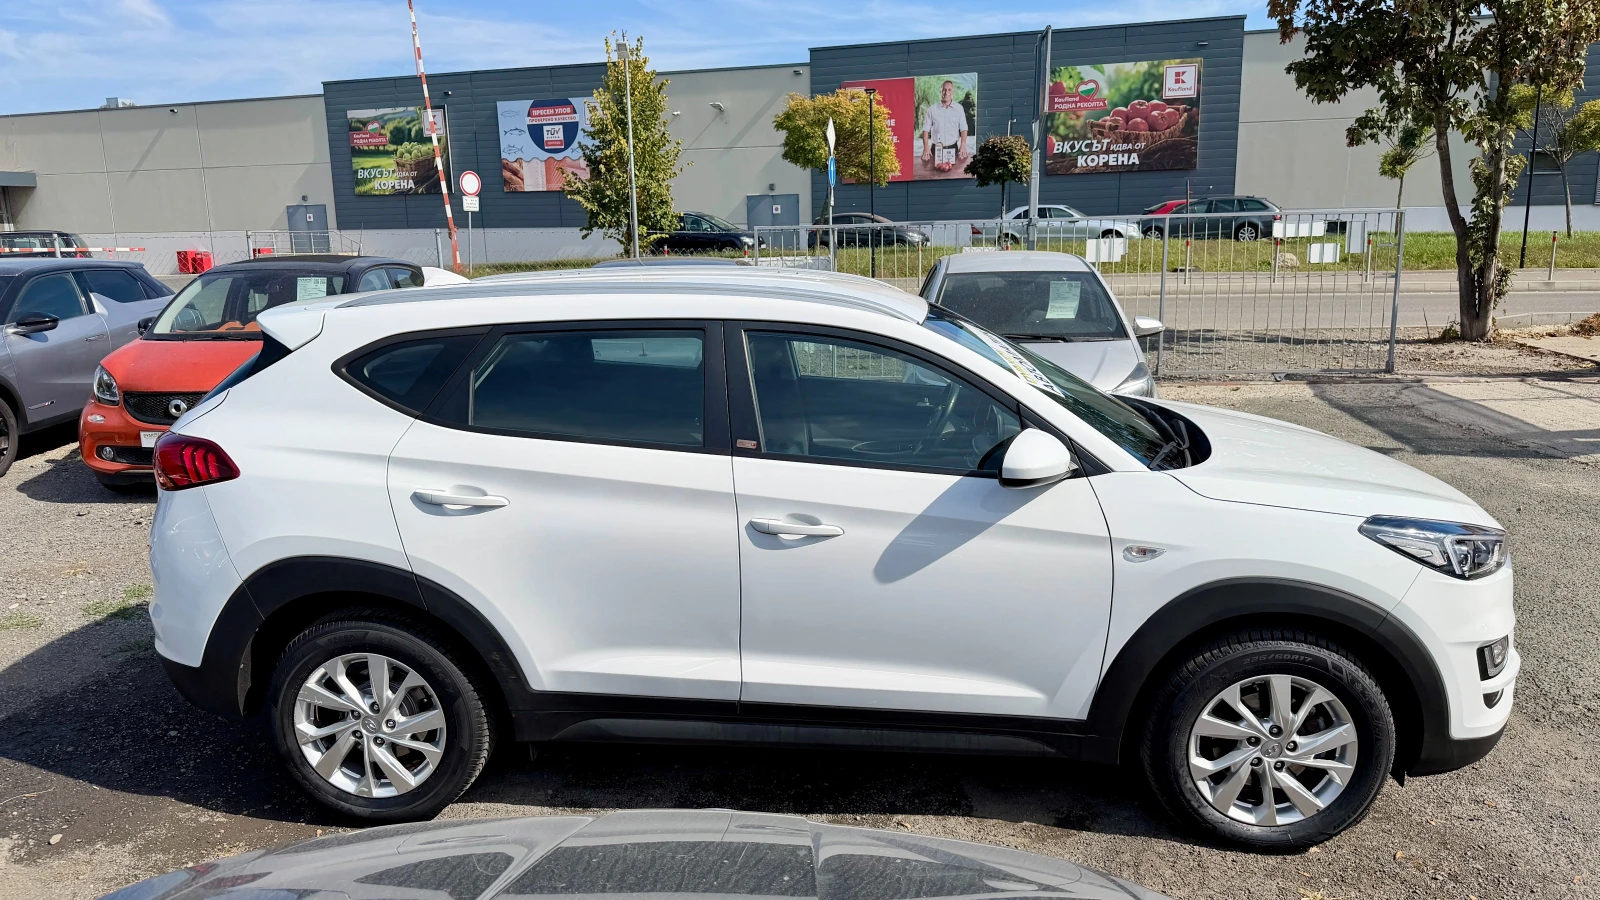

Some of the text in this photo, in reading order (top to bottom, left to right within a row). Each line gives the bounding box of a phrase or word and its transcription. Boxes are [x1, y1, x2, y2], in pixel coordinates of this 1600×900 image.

[532, 108, 554, 116] ПРЕСЕН
[1053, 139, 1146, 154] ВКУСЪТ ИДВА ОТ
[1077, 153, 1140, 167] КОРЕНА
[357, 168, 395, 179] ВКУСЪТ
[374, 180, 415, 190] КОРЕНА
[1243, 653, 1313, 665] 225/60R17
